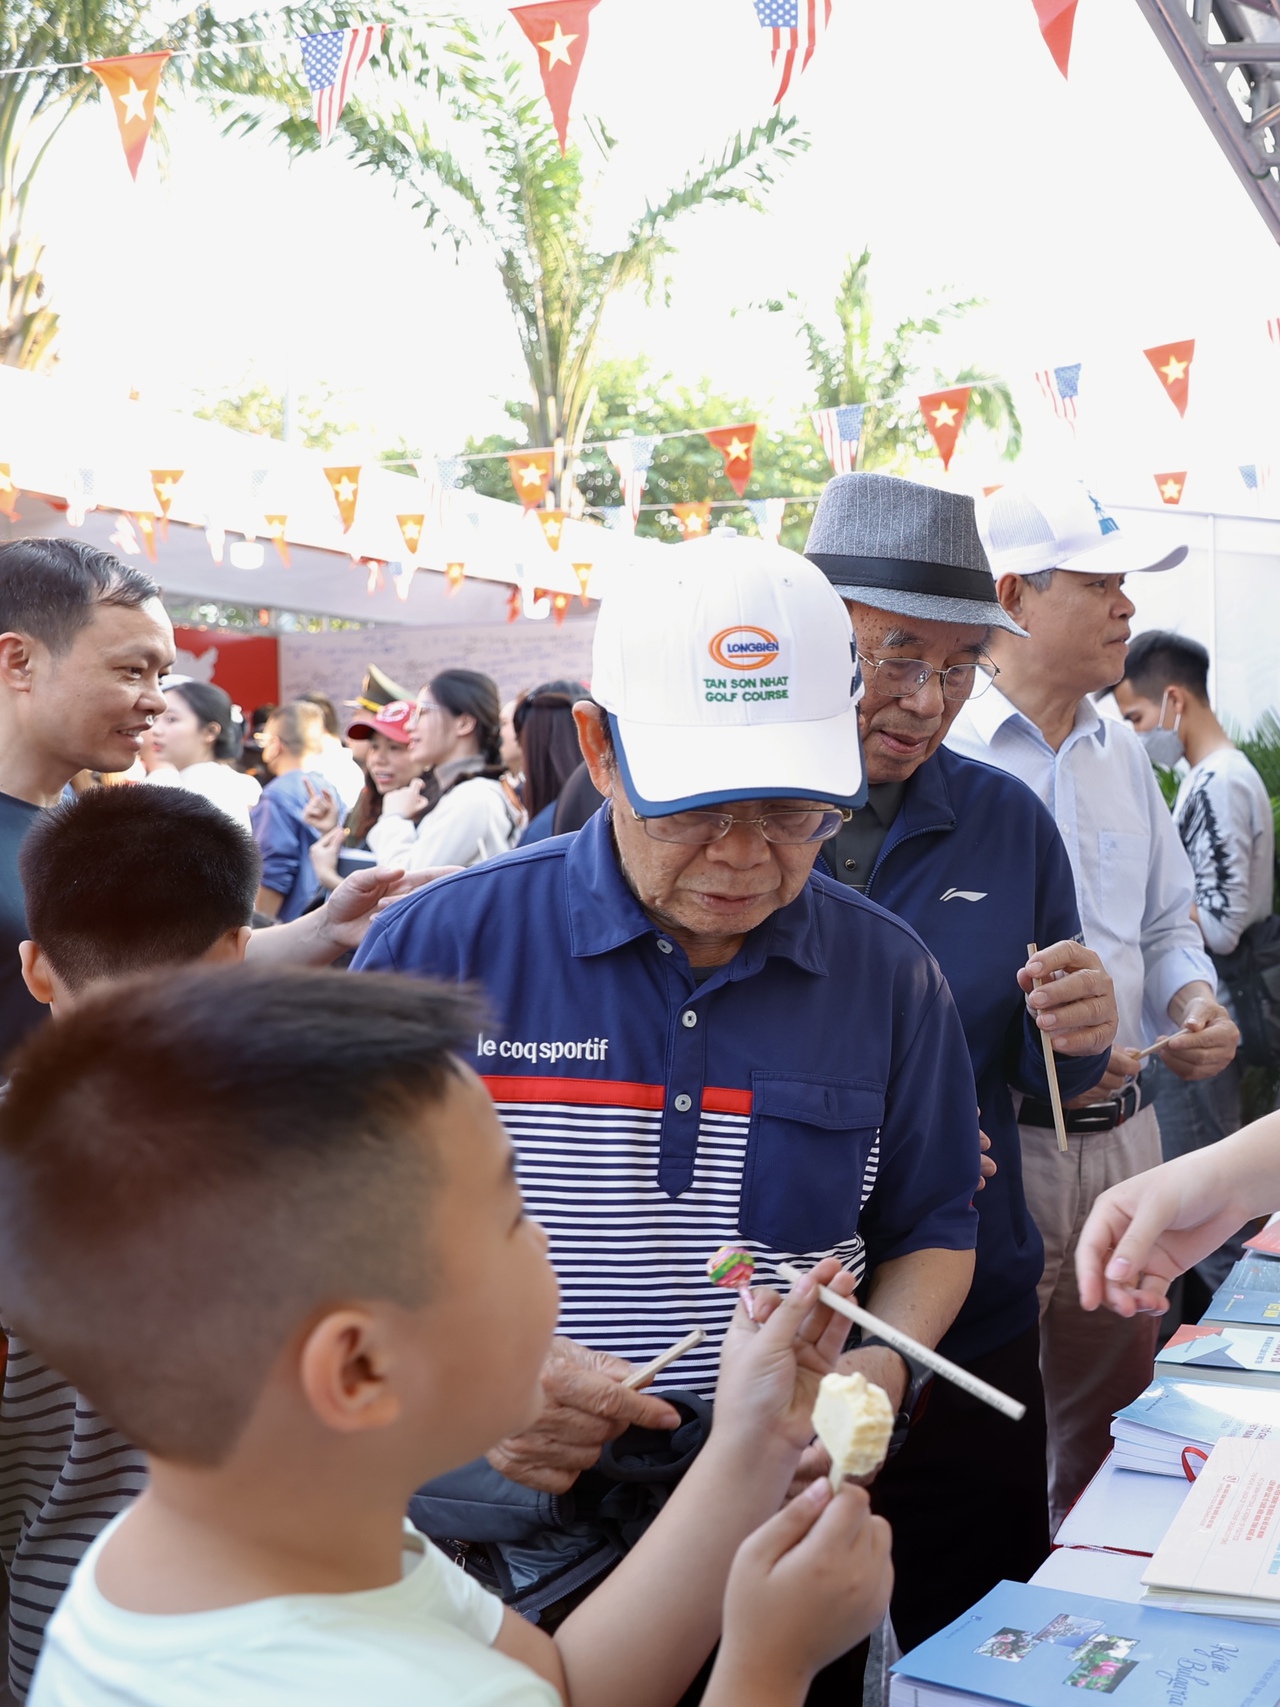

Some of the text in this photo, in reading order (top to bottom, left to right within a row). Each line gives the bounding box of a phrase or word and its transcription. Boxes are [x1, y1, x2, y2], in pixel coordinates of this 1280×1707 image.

[727, 642, 779, 652] LONGBIEN
[704, 676, 789, 689] TAN SON NHAT
[705, 690, 789, 702] GOLF COURSE
[477, 1032, 609, 1064] le coq sportif
